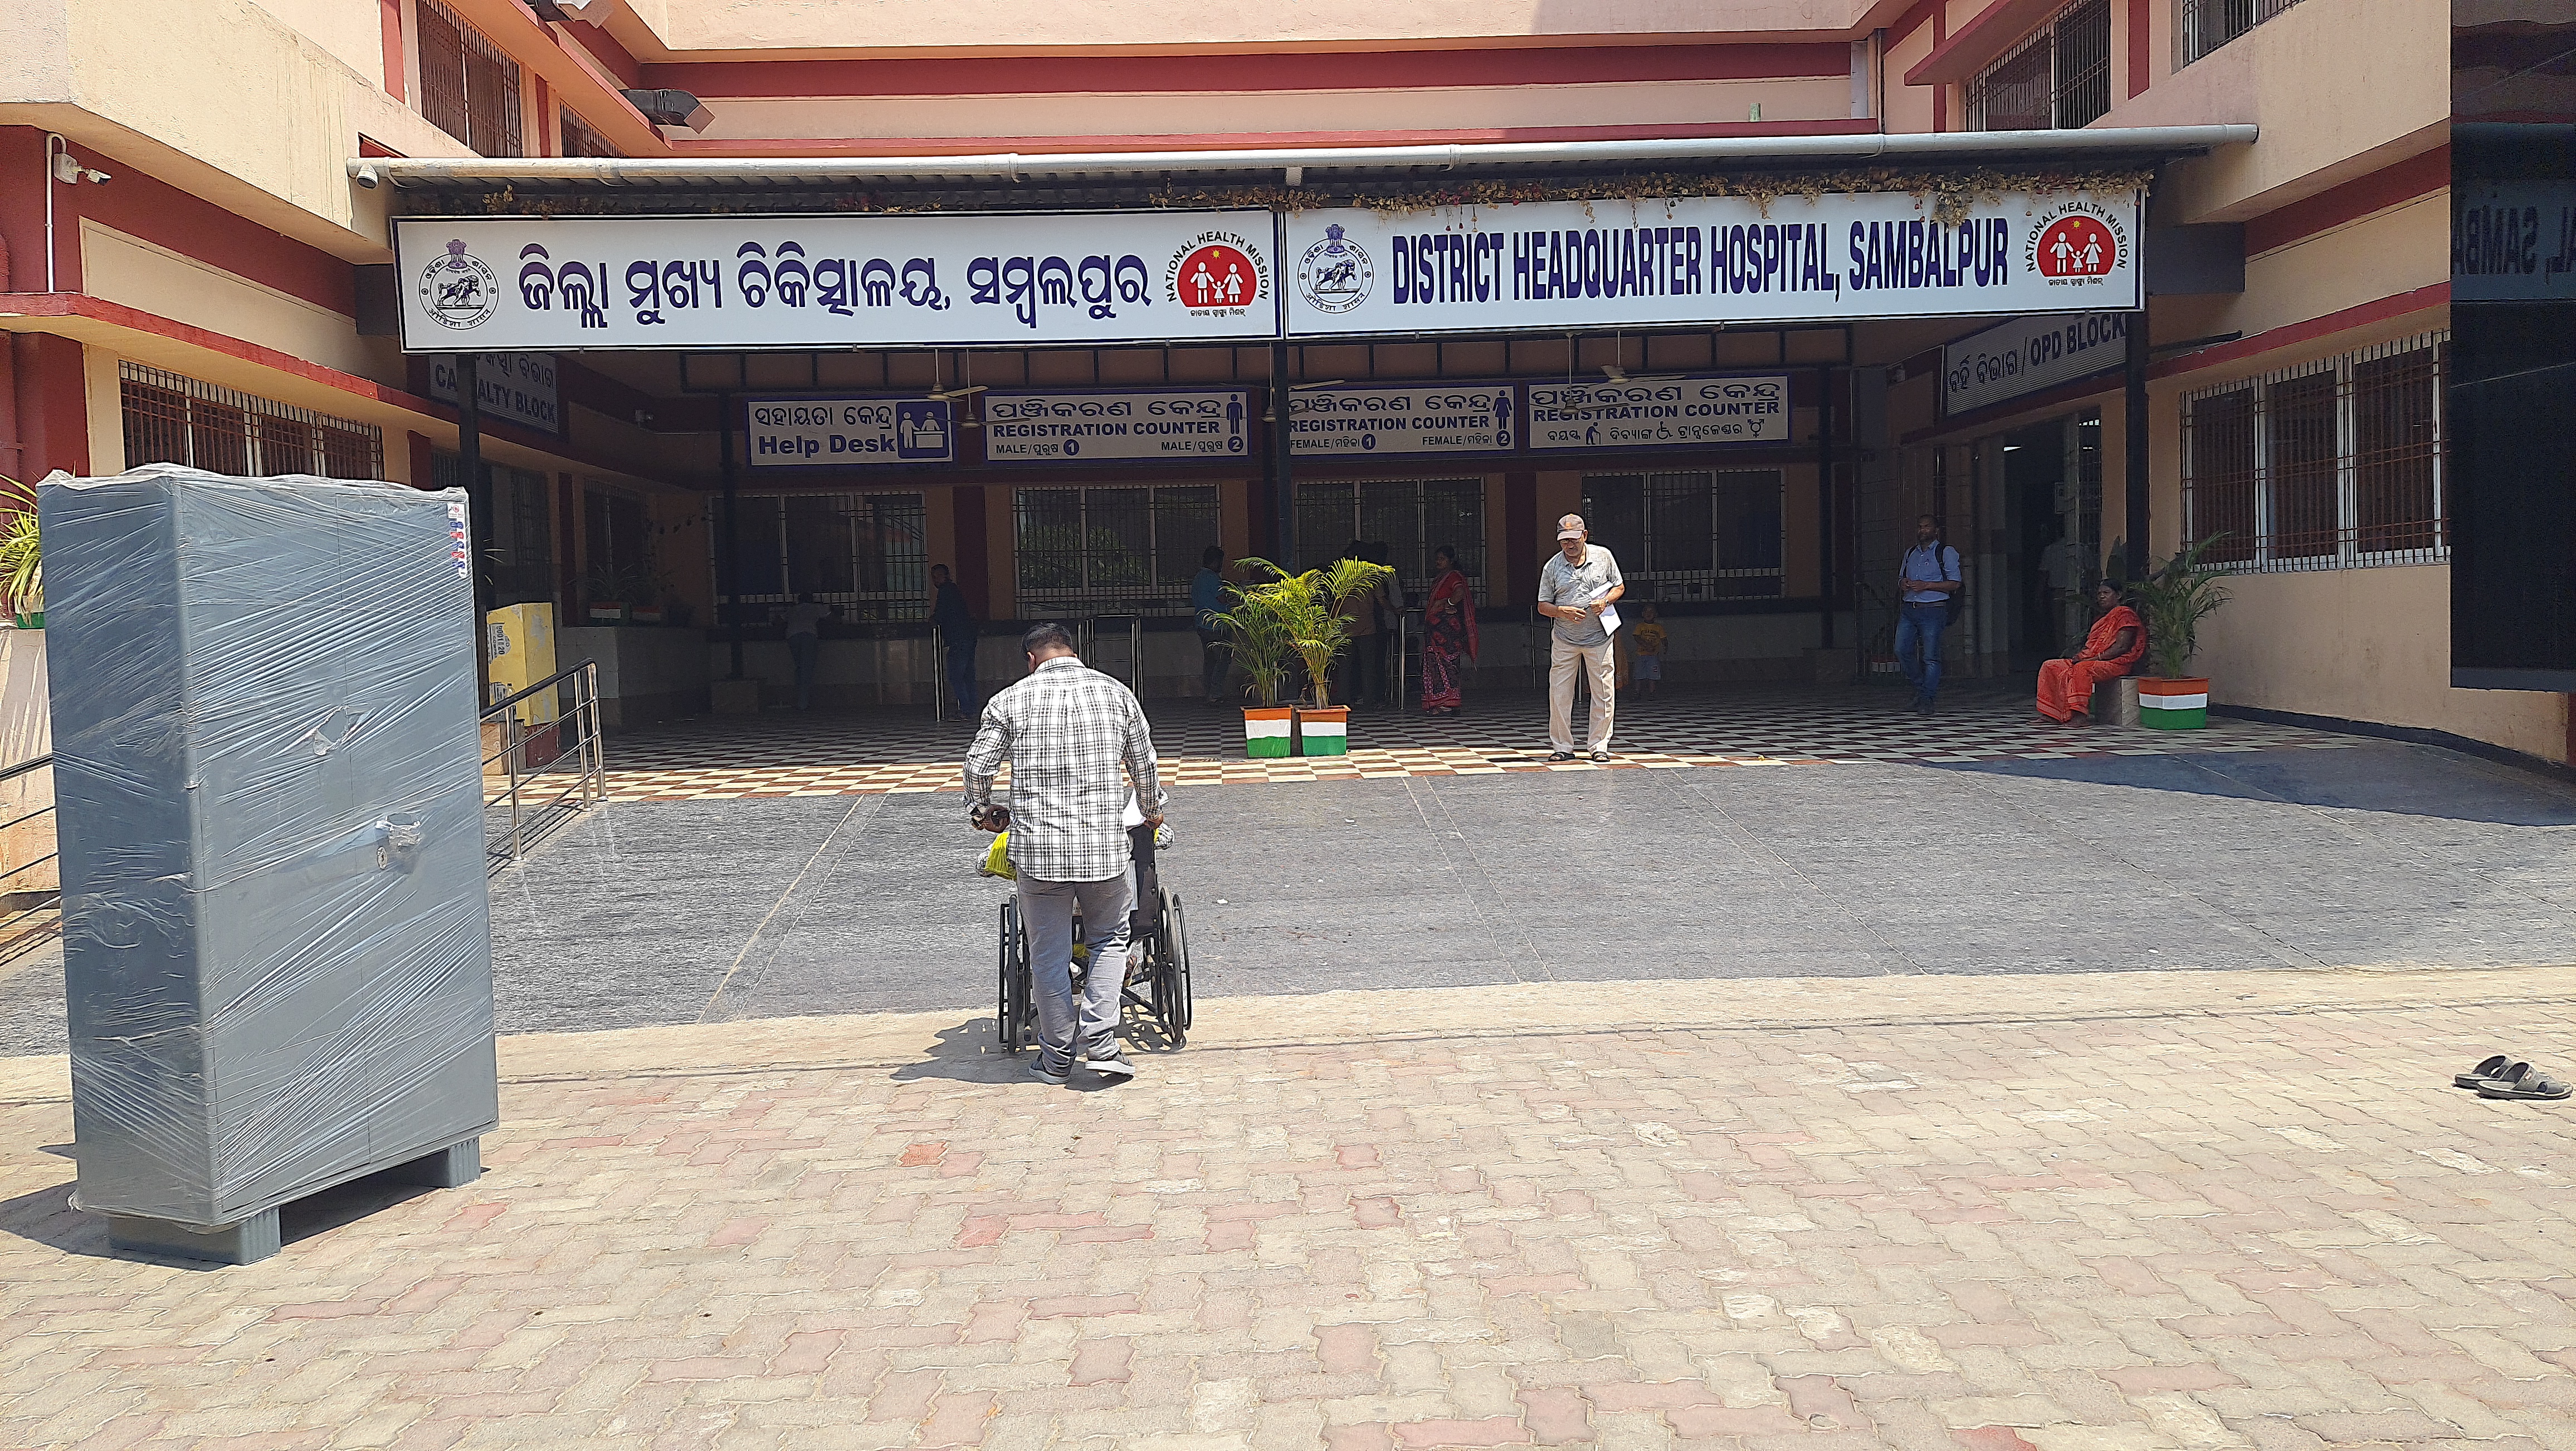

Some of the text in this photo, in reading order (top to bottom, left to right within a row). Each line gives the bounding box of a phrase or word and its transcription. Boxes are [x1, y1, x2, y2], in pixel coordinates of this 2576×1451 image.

[2025, 202, 2128, 272] NATIONAL HEALTH MISSION
[1165, 231, 1269, 302] NATIONAL HEALTH MISSION
[1393, 218, 2008, 305] DISTRICT HEADQUARTER HOSPITAL, SAMBALPUR
[519, 241, 1152, 329] ଜିଲ୍ଲା ମୁଖ୍ୟ ଚିକିତ୍ସାଳୟ, ସମ୍ବଲପୁର
[2067, 314, 2125, 354] BLOCK
[436, 364, 511, 408] CAALTY
[515, 391, 557, 423] BLOCK
[1425, 394, 1491, 412] କେନ୍ଦ୍ର
[1700, 383, 1780, 401] କେନ୍ଦ୍ର
[754, 405, 892, 429] ସହାୟତା କେନ୍ଦ୍ର
[1148, 399, 1221, 418] କେନ୍ଦ୍ର
[1534, 402, 1779, 422] REGISTRATION COUNTER
[993, 421, 1220, 437] REGISTRATION COUNTER
[1290, 415, 1489, 432] REGISTRATION COUNTER
[759, 434, 896, 458] Help Desk
